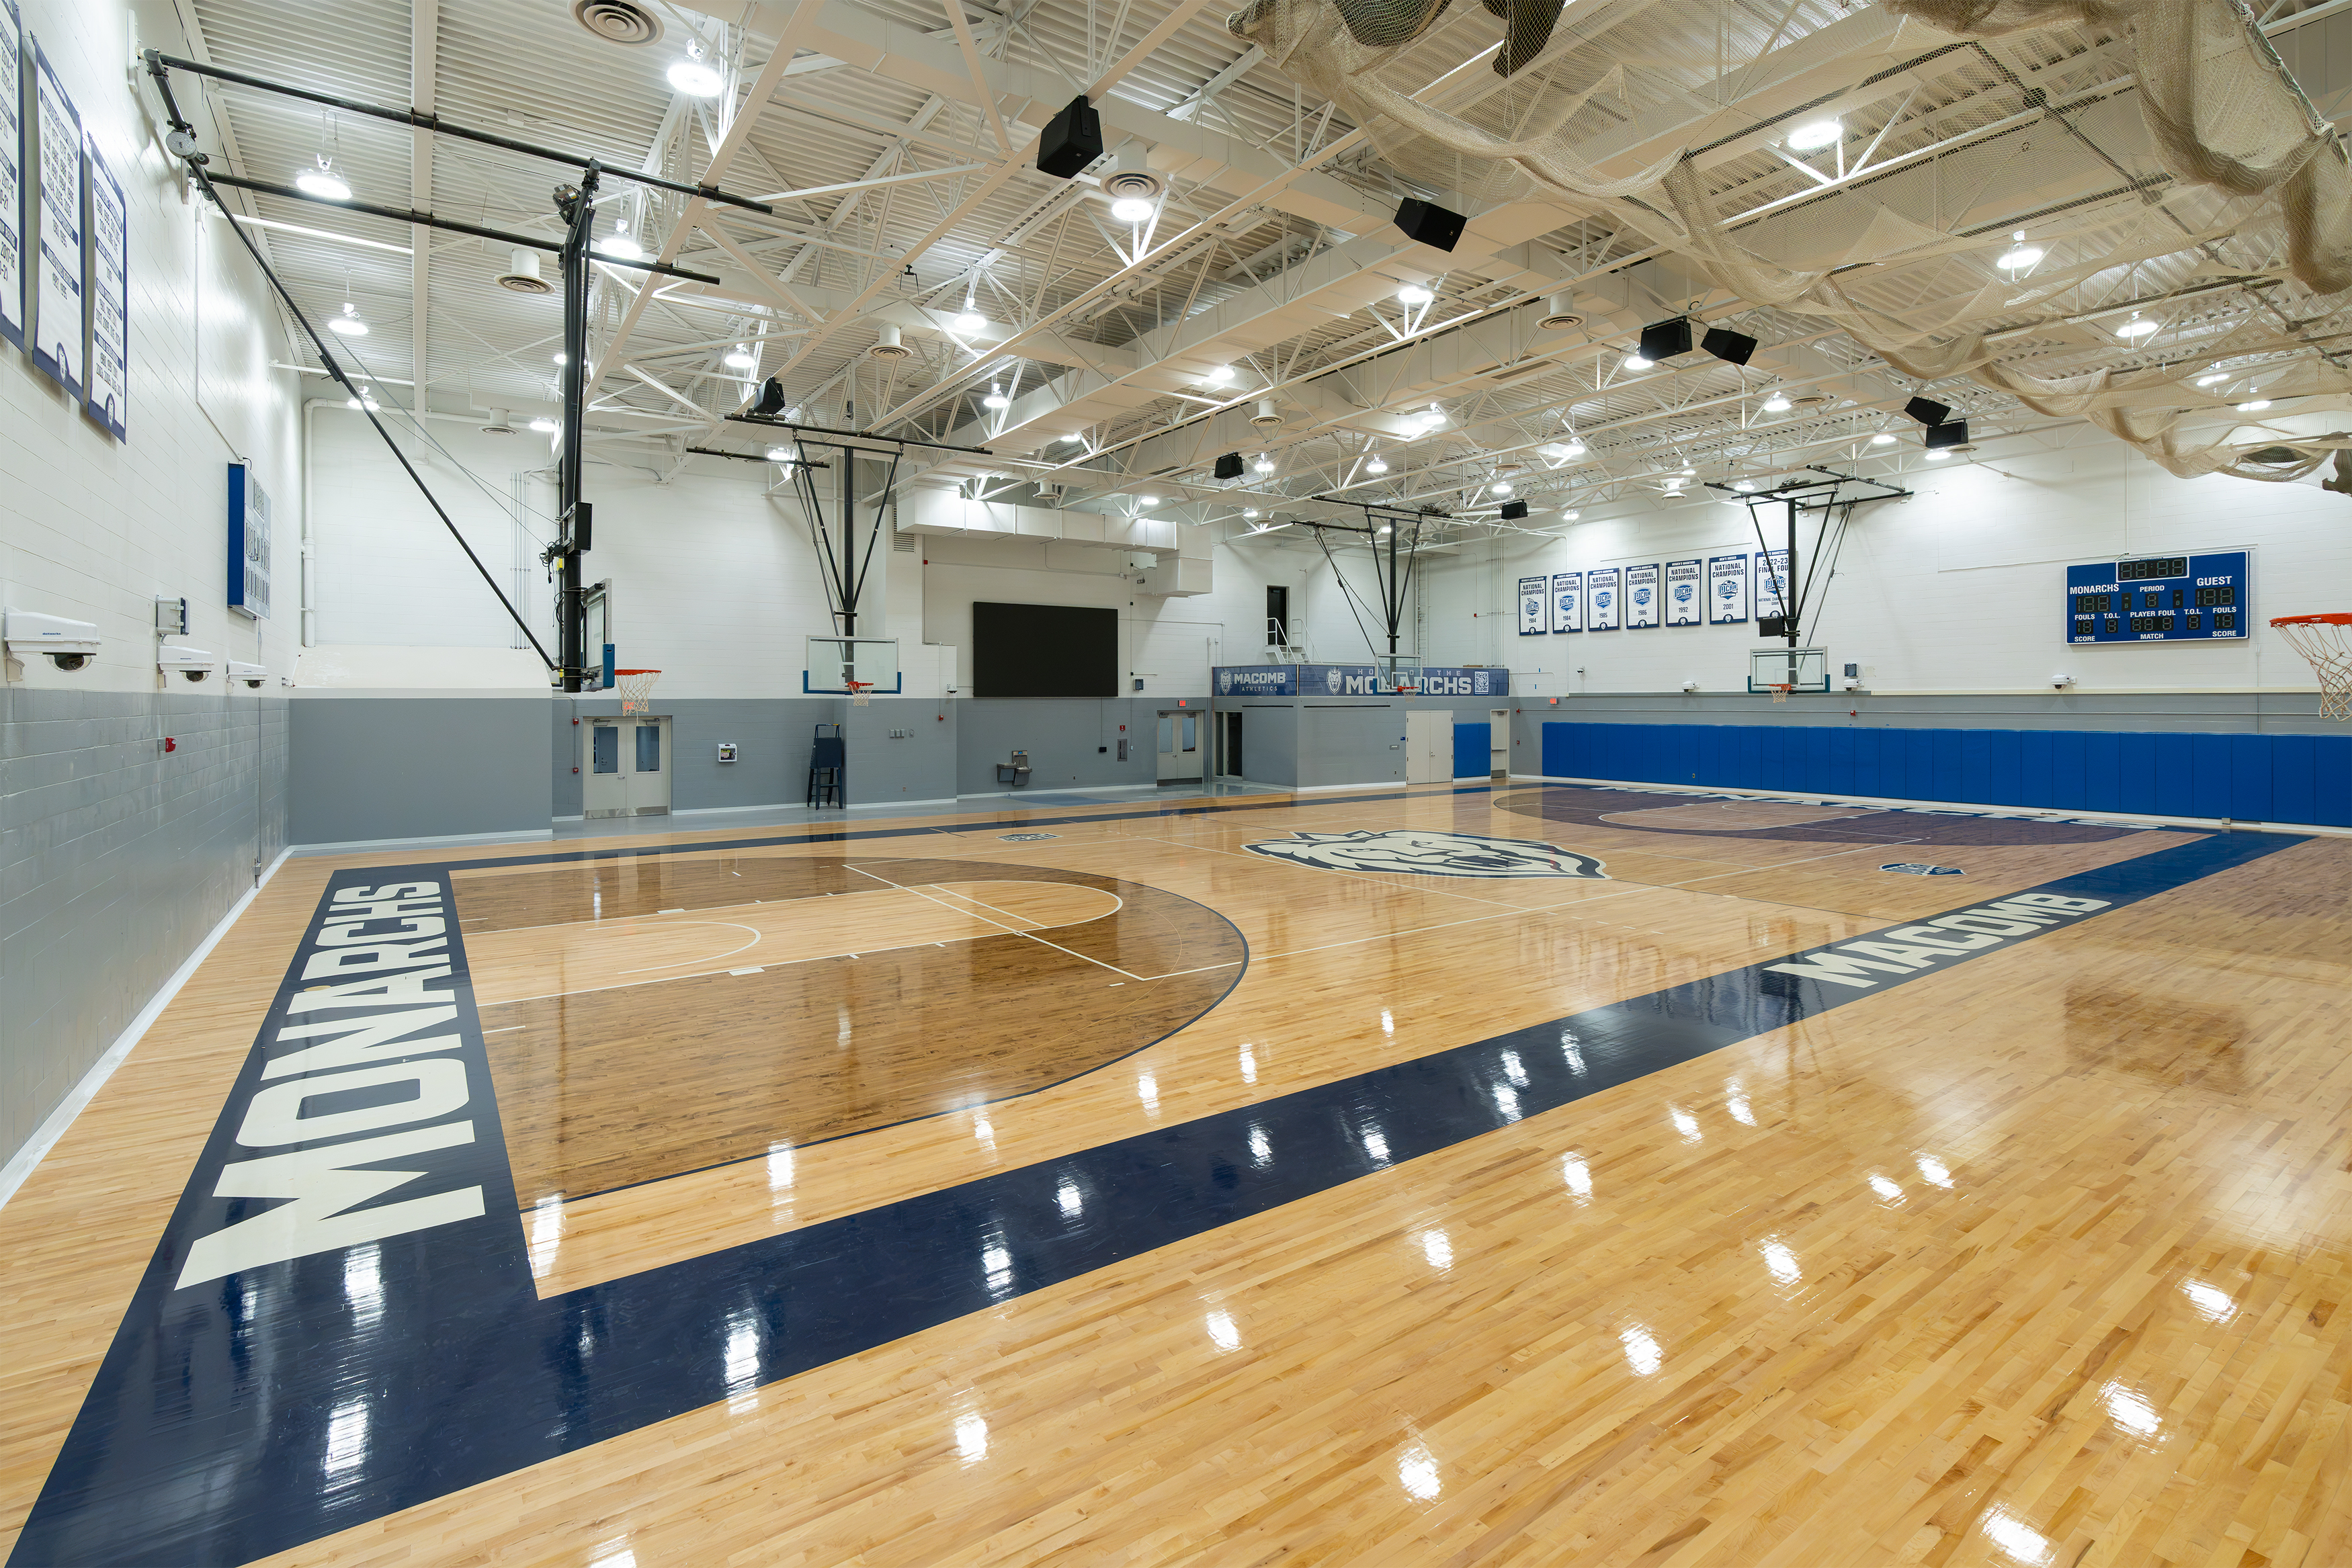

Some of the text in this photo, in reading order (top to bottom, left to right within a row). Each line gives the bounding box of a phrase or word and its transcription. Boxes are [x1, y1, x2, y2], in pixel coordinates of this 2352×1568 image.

[1763, 558, 1788, 566] 222-23
[1669, 574, 1698, 582] CHAMPIONS
[1713, 569, 1744, 578] CHAMPIONS
[1629, 578, 1656, 586] CHAMPIONS
[1765, 579, 1784, 589] NJAA
[2197, 576, 2232, 586] GUEST
[1675, 588, 1692, 597] NJCAA
[1718, 584, 1736, 595] NJCAA
[2070, 584, 2119, 595] MONARCHS
[1596, 595, 1611, 603] NJCAA
[1634, 591, 1650, 600] NJCAA
[1560, 598, 1574, 607] NJCAA
[1234, 672, 1286, 684] MACOMB
[1762, 893, 2112, 989] MACOMB
[173, 881, 486, 1291] MONARCHS
